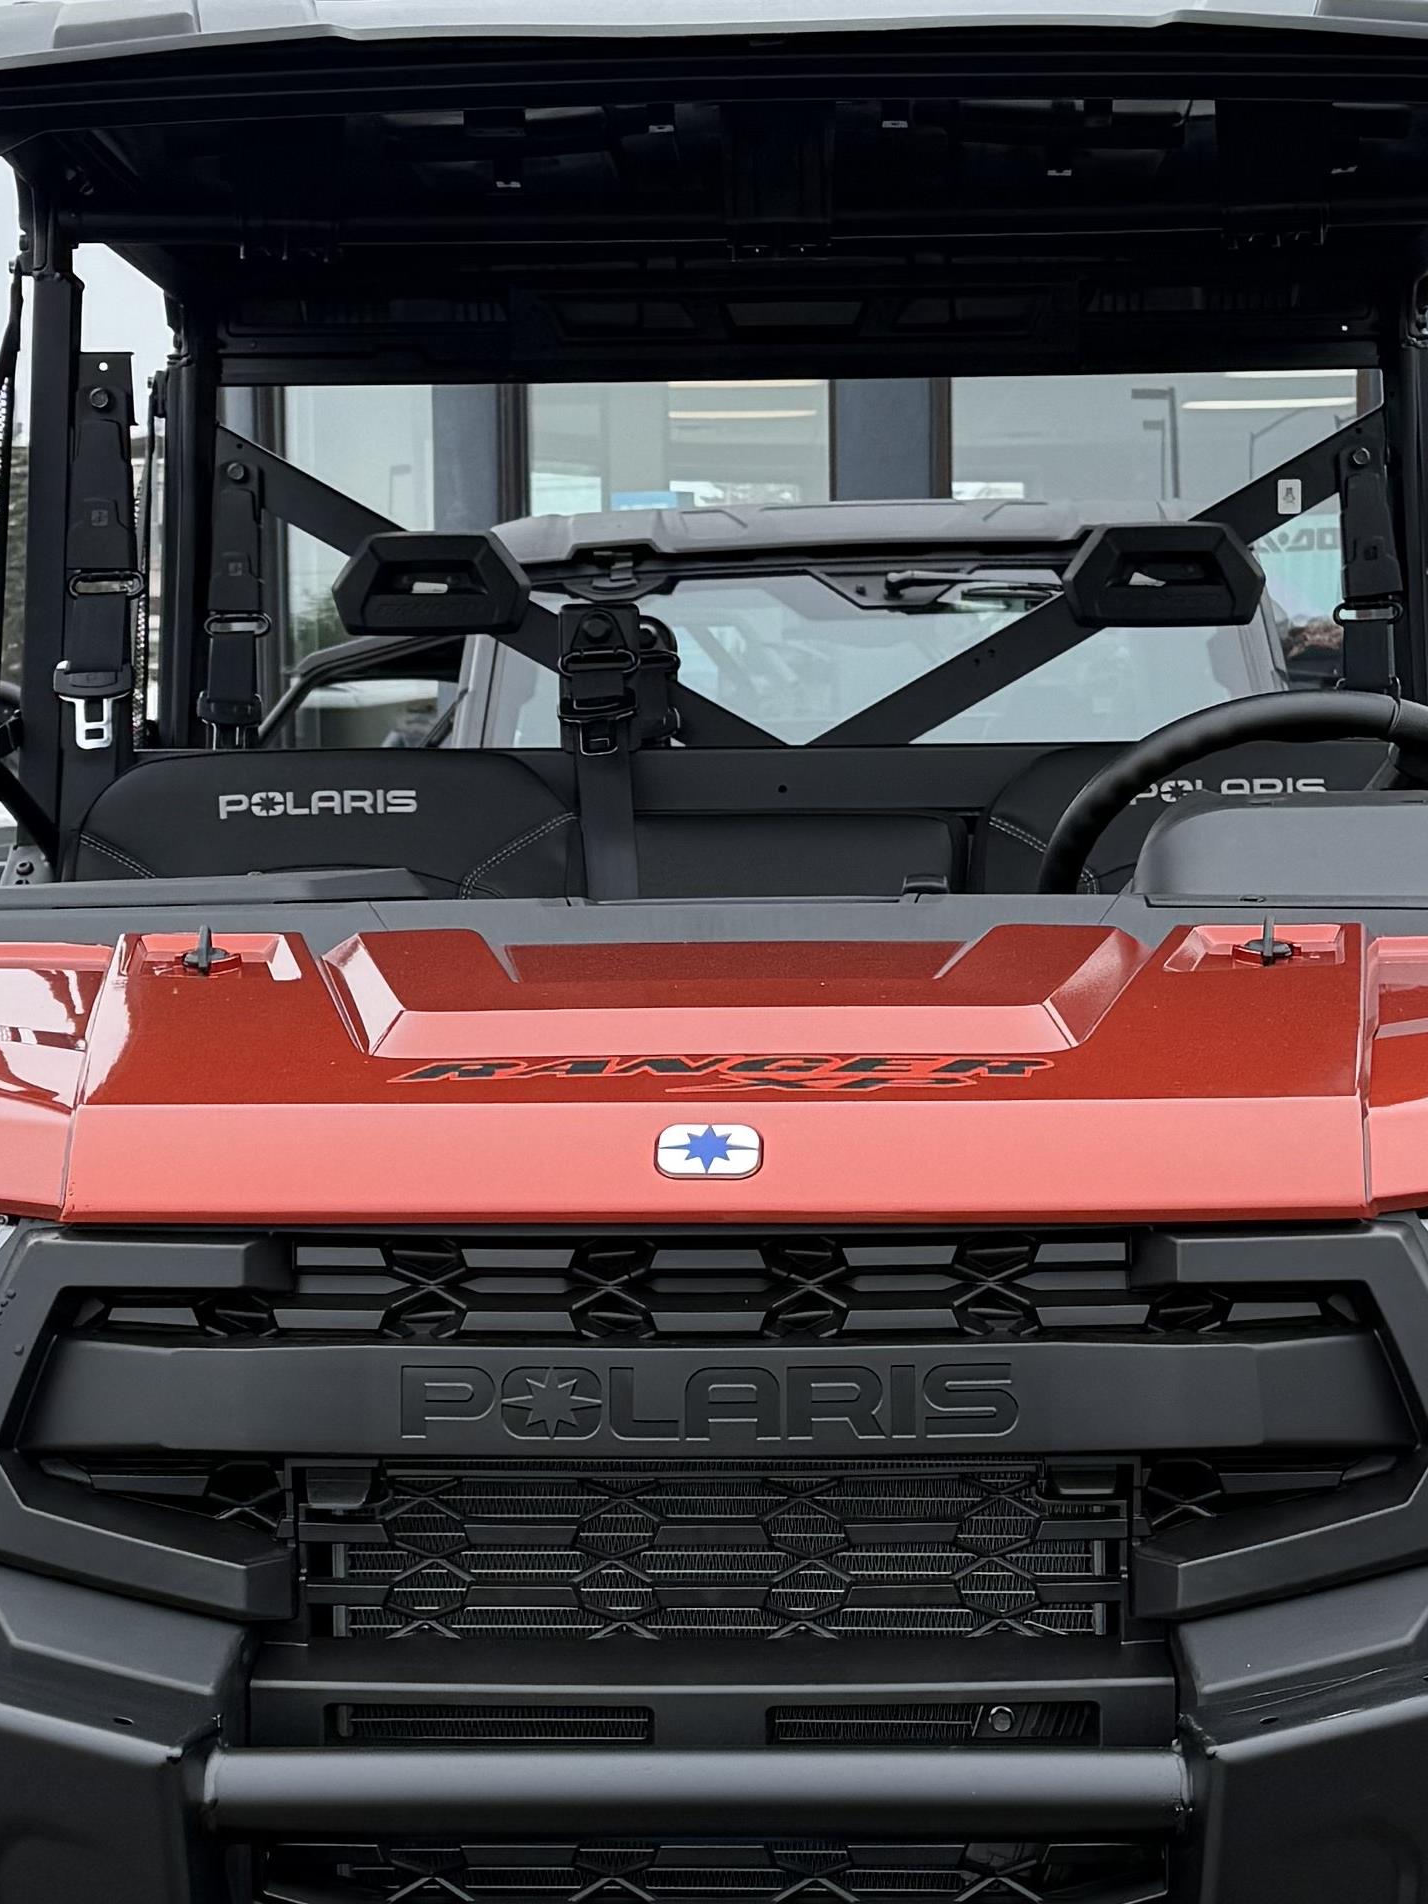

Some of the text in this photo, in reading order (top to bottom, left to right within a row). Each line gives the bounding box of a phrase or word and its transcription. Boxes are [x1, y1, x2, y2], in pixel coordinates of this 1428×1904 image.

[218, 788, 418, 821] POLARIS
[1128, 777, 1328, 806] POARIS
[386, 1055, 1055, 1083] RANGER
[666, 1073, 978, 1093] XP
[400, 1362, 1020, 1442] POLARIS
